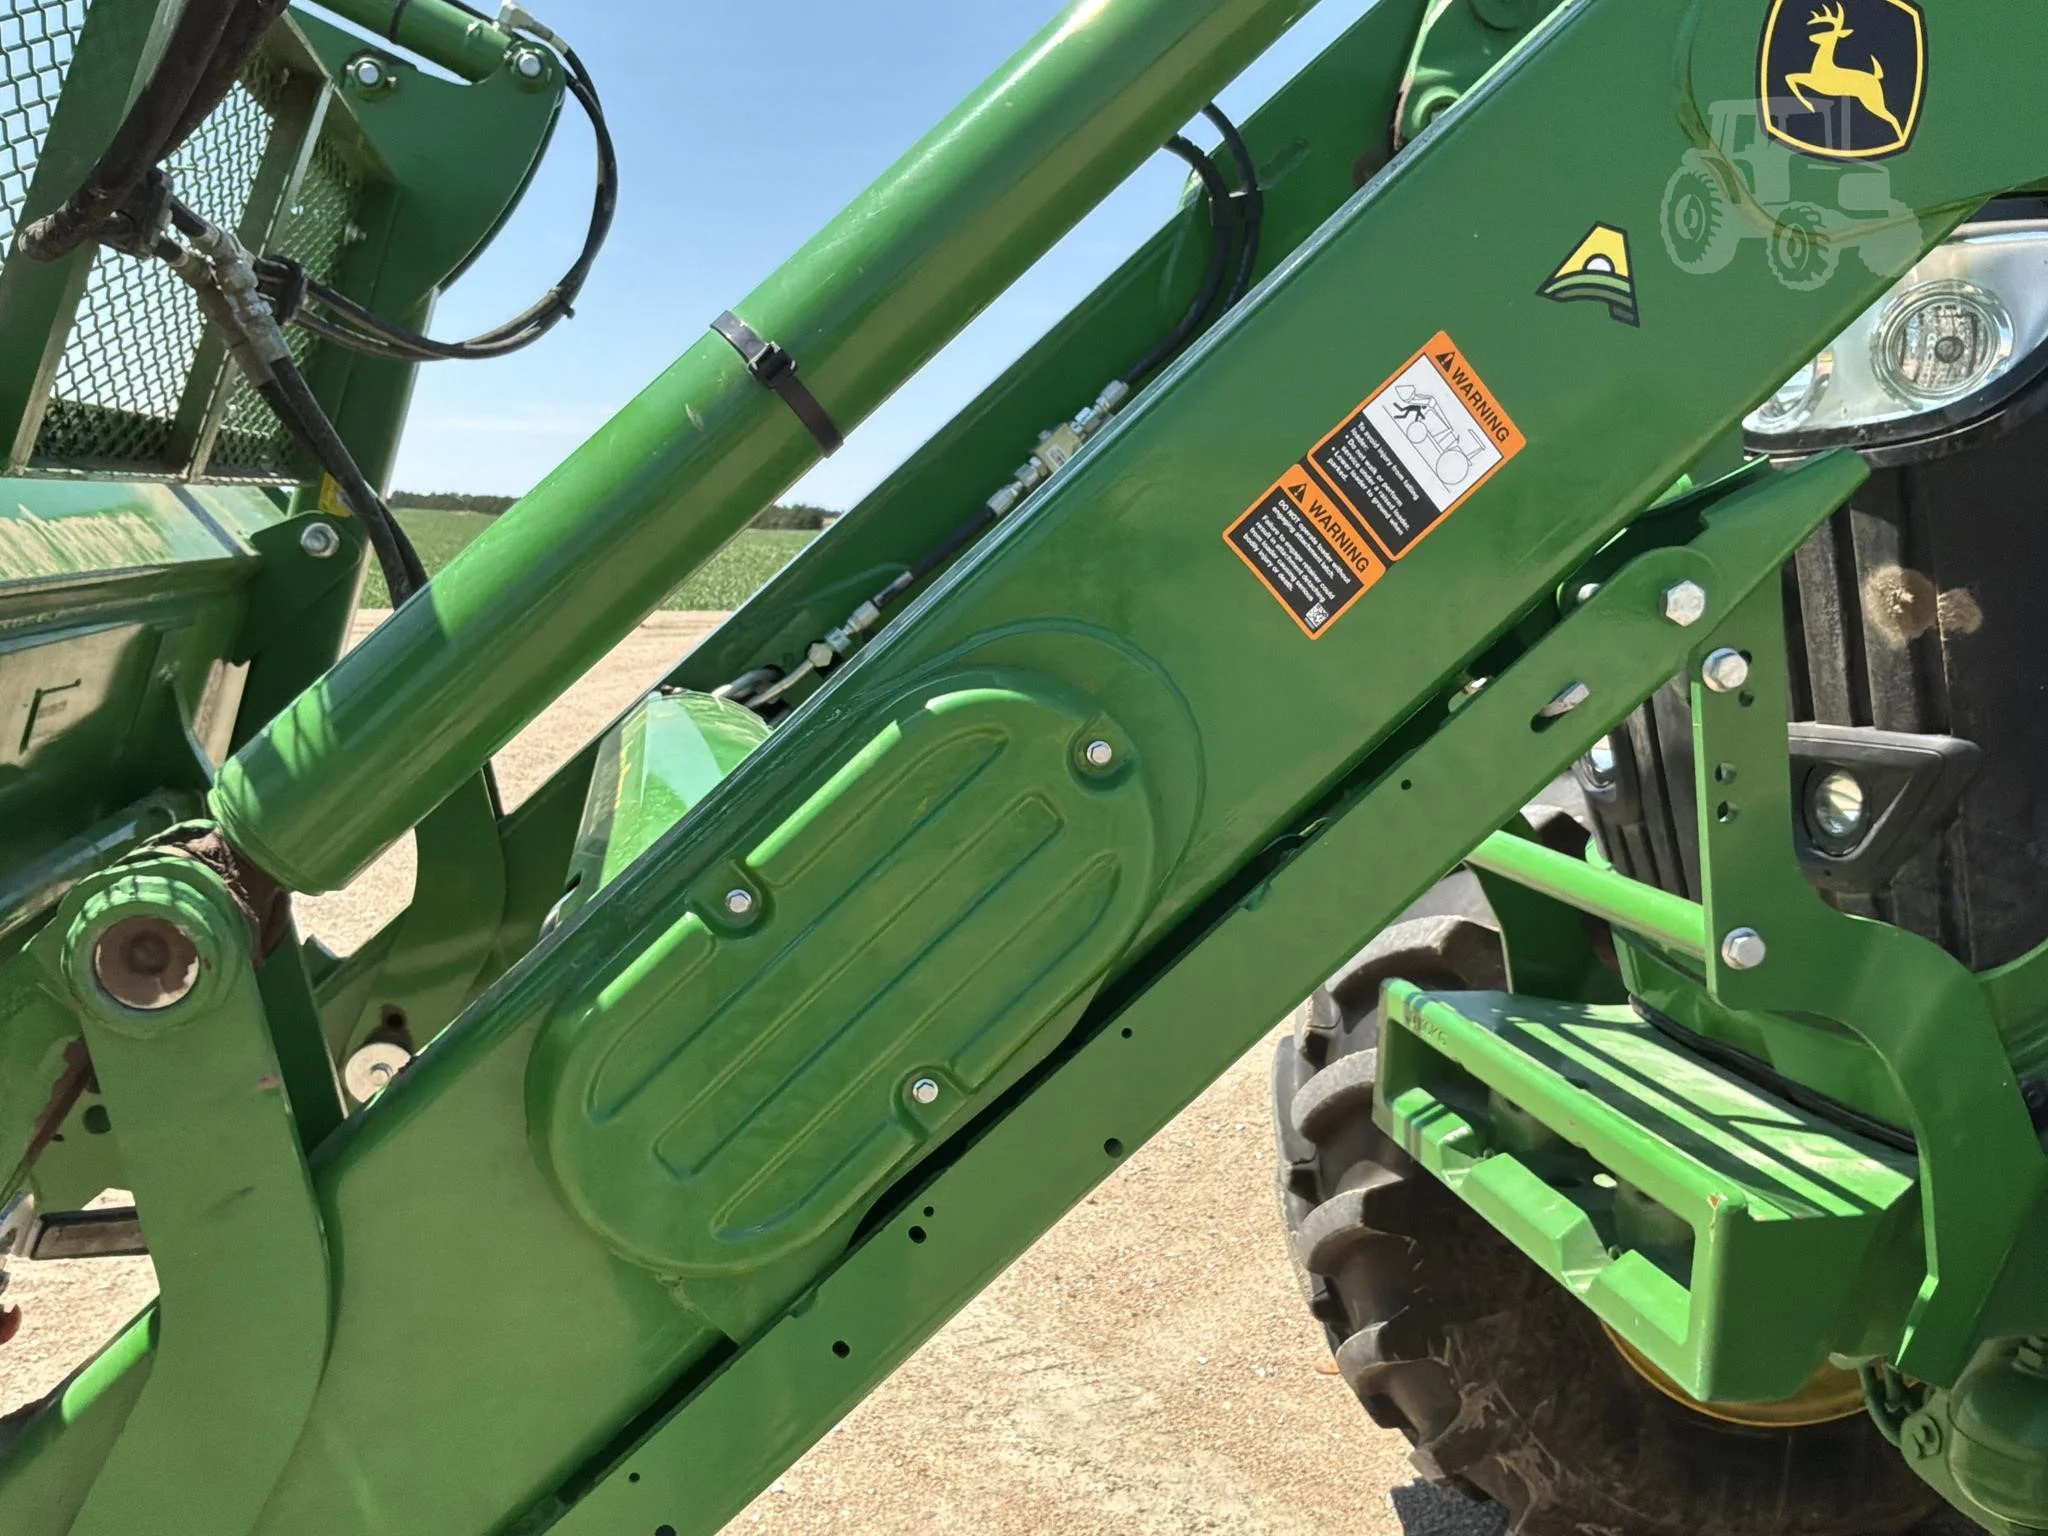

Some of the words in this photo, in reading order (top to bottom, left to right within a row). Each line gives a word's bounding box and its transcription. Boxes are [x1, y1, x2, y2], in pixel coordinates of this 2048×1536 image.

[1450, 365, 1511, 443] WARNING
[1333, 449, 1352, 471] Lower
[1349, 468, 1368, 490] loader
[1365, 488, 1374, 498] to
[1370, 495, 1391, 520] ground
[1388, 517, 1404, 535] when
[1340, 444, 1361, 469] service
[1358, 466, 1376, 486] under
[1377, 489, 1395, 510] raised
[1346, 437, 1357, 450] Do
[1354, 448, 1366, 461] not
[1363, 458, 1378, 475] walk
[1375, 473, 1384, 483] or
[1380, 481, 1403, 507] perform
[1357, 420, 1366, 432] To
[1362, 429, 1380, 449] avoid
[1376, 446, 1393, 467] injury
[1390, 463, 1405, 481] from
[1401, 478, 1420, 501] falling
[1241, 532, 1260, 552] bodily
[1257, 548, 1274, 568] injury
[1271, 565, 1279, 574] or
[1248, 526, 1263, 542] from
[1260, 539, 1279, 560] loader
[1275, 558, 1297, 582] causing
[1294, 579, 1314, 602] serious
[1254, 520, 1272, 539] result
[1269, 536, 1277, 545] in
[1274, 542, 1304, 576] attachment
[1300, 573, 1326, 603] detaching
[1261, 514, 1280, 536] Failure
[1277, 533, 1286, 542] to
[1283, 540, 1303, 563] engage
[1301, 560, 1322, 583] retainer
[1319, 581, 1335, 600] could
[1271, 505, 1296, 534] engaging
[1293, 530, 1323, 564] attachment
[1277, 498, 1289, 511] DO
[1286, 508, 1301, 524] NOT
[1297, 521, 1318, 545] operate
[1315, 542, 1334, 563] loader
[1330, 560, 1351, 584] without
[1307, 498, 1371, 573] WARNING
